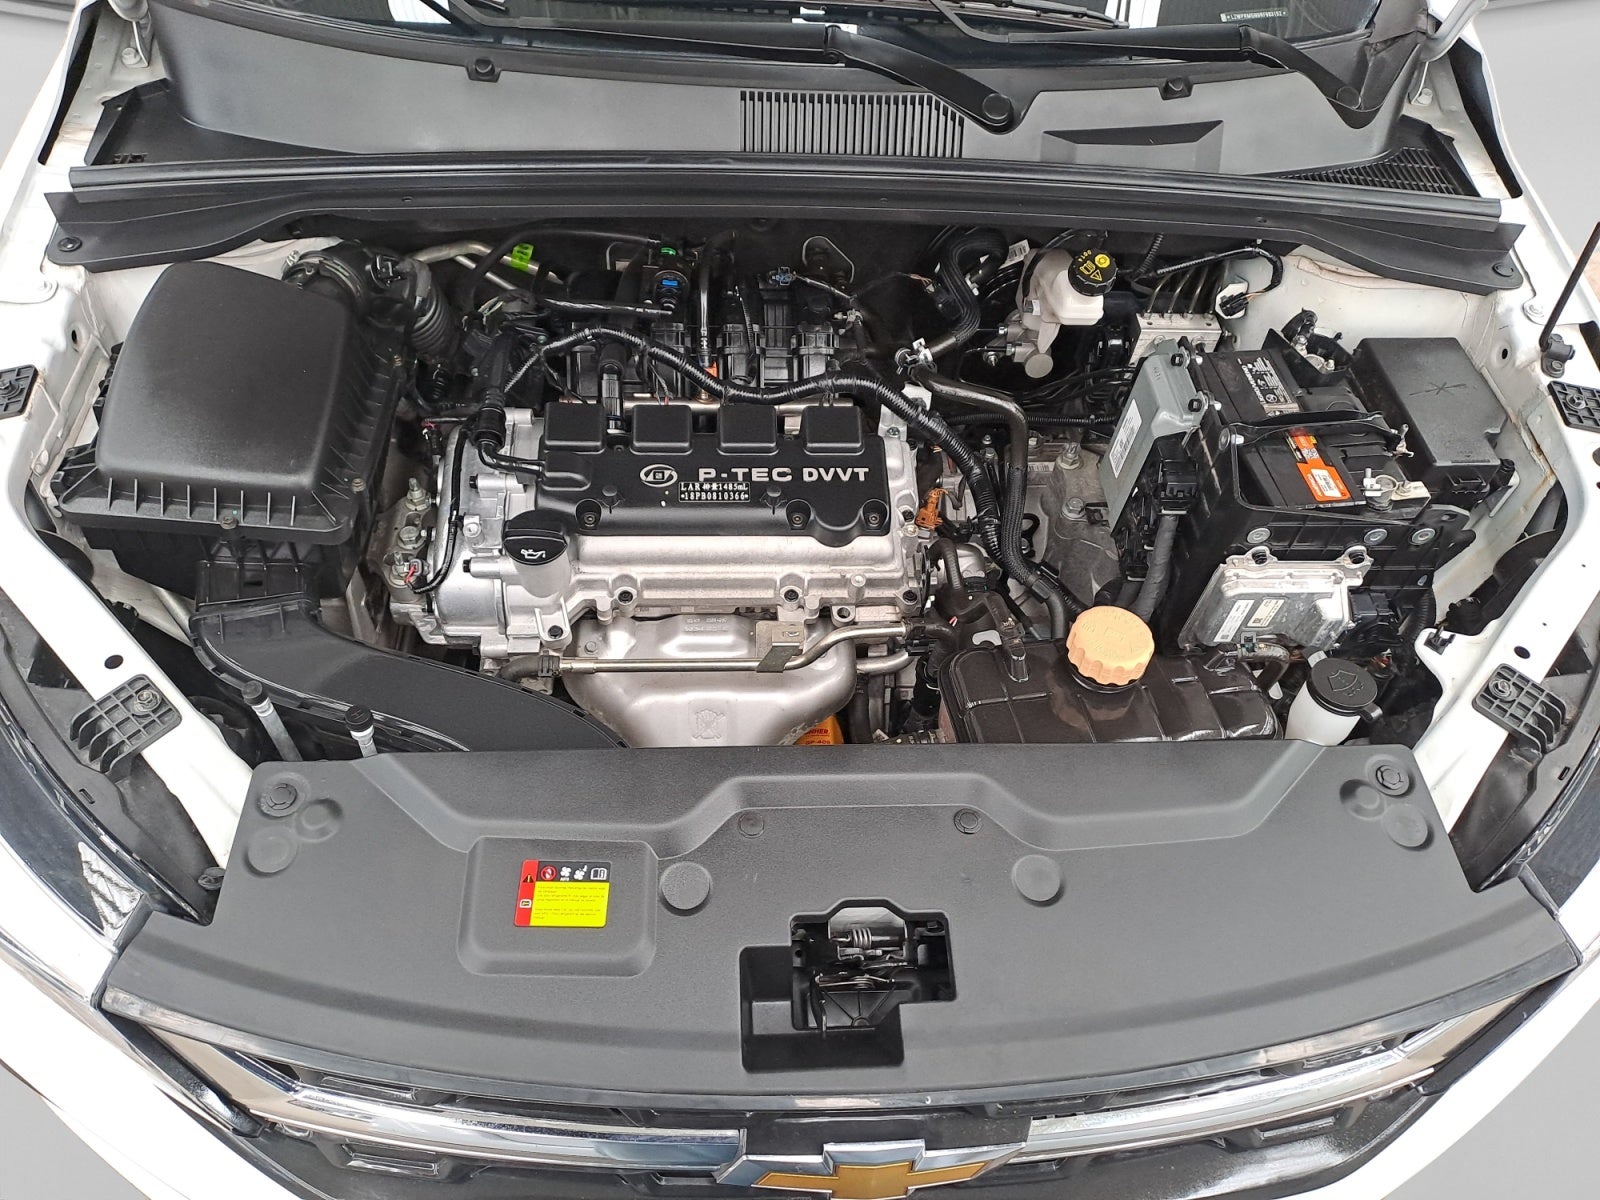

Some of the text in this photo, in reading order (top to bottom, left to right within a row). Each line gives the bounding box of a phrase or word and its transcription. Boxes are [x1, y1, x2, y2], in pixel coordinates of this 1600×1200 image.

[698, 467, 870, 482] P-TEC DVVT
[680, 482, 701, 491] LAR
